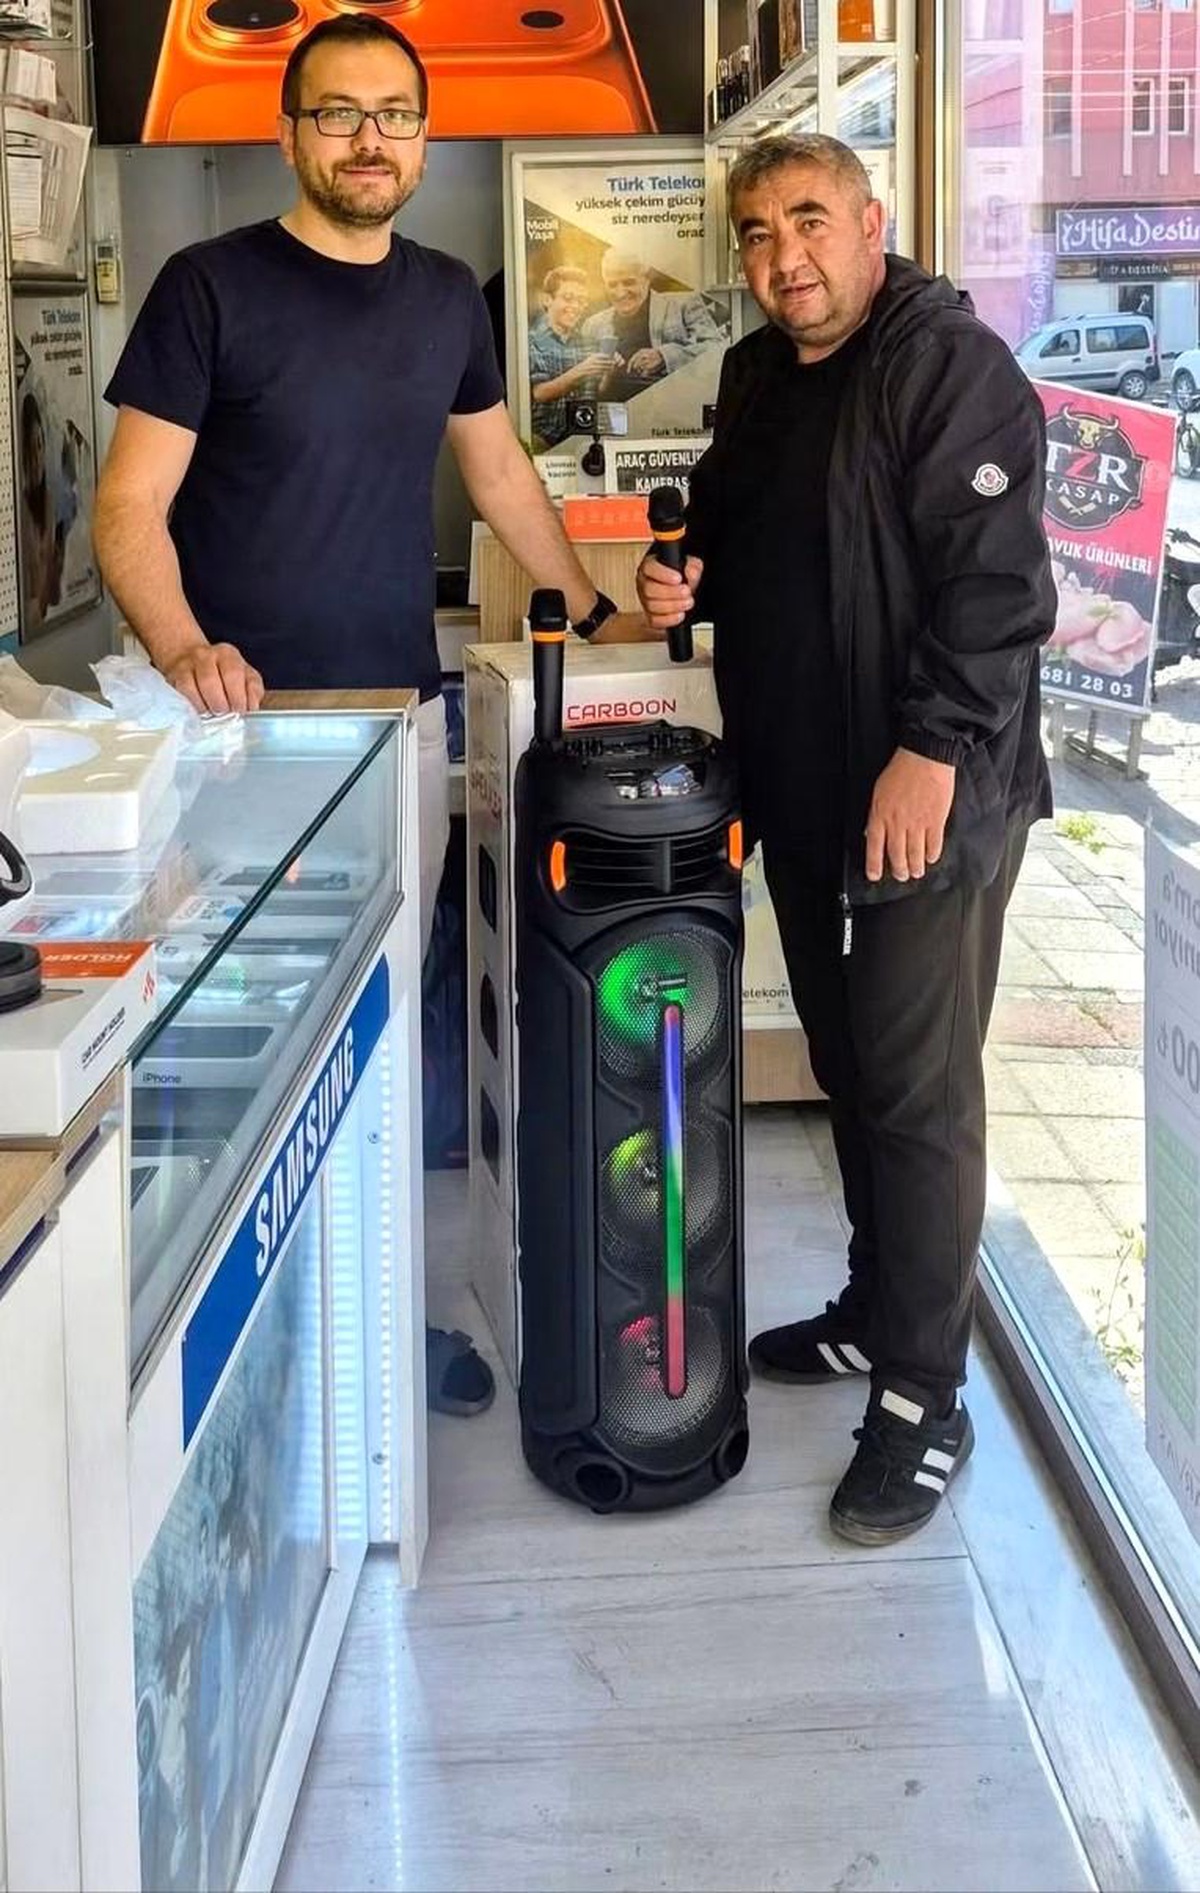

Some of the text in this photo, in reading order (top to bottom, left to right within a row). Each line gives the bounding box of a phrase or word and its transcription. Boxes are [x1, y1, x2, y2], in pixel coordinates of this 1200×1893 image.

[607, 177, 645, 192] Türk
[576, 199, 621, 211] yüksek
[625, 196, 664, 208] çekim
[612, 214, 629, 224] siz
[616, 452, 647, 471] ARAÇ
[1045, 439, 1132, 493] TZR
[1085, 541, 1155, 576] ÜRÜNLERİ
[1080, 674, 1104, 692] 28
[1110, 681, 1133, 698] 03
[567, 699, 677, 721] CARBOON
[44, 953, 134, 962] HOLDER
[142, 1072, 182, 1084] iPhone
[255, 1026, 357, 1279] SAMSUNG
